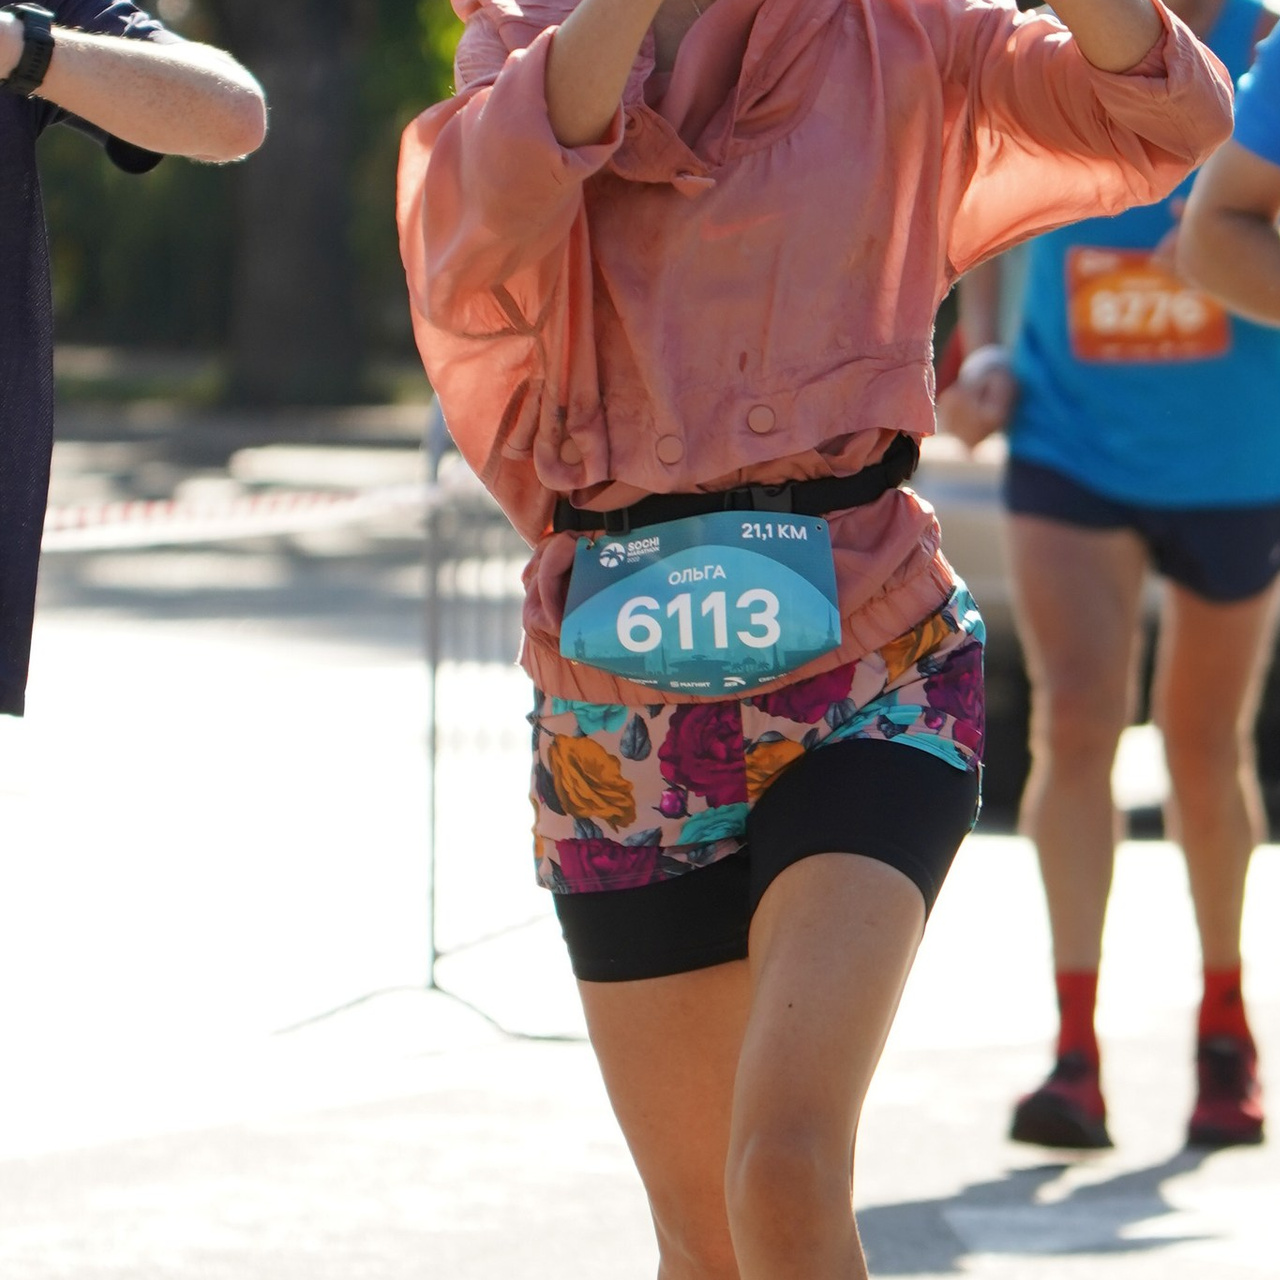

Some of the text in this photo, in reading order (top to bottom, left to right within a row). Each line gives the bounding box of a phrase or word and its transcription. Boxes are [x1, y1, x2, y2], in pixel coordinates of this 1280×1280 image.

[741, 522, 773, 541] 21,1
[627, 536, 660, 552] SOCHI
[668, 564, 728, 586] ОЛЬГА
[616, 588, 782, 653] 6113
